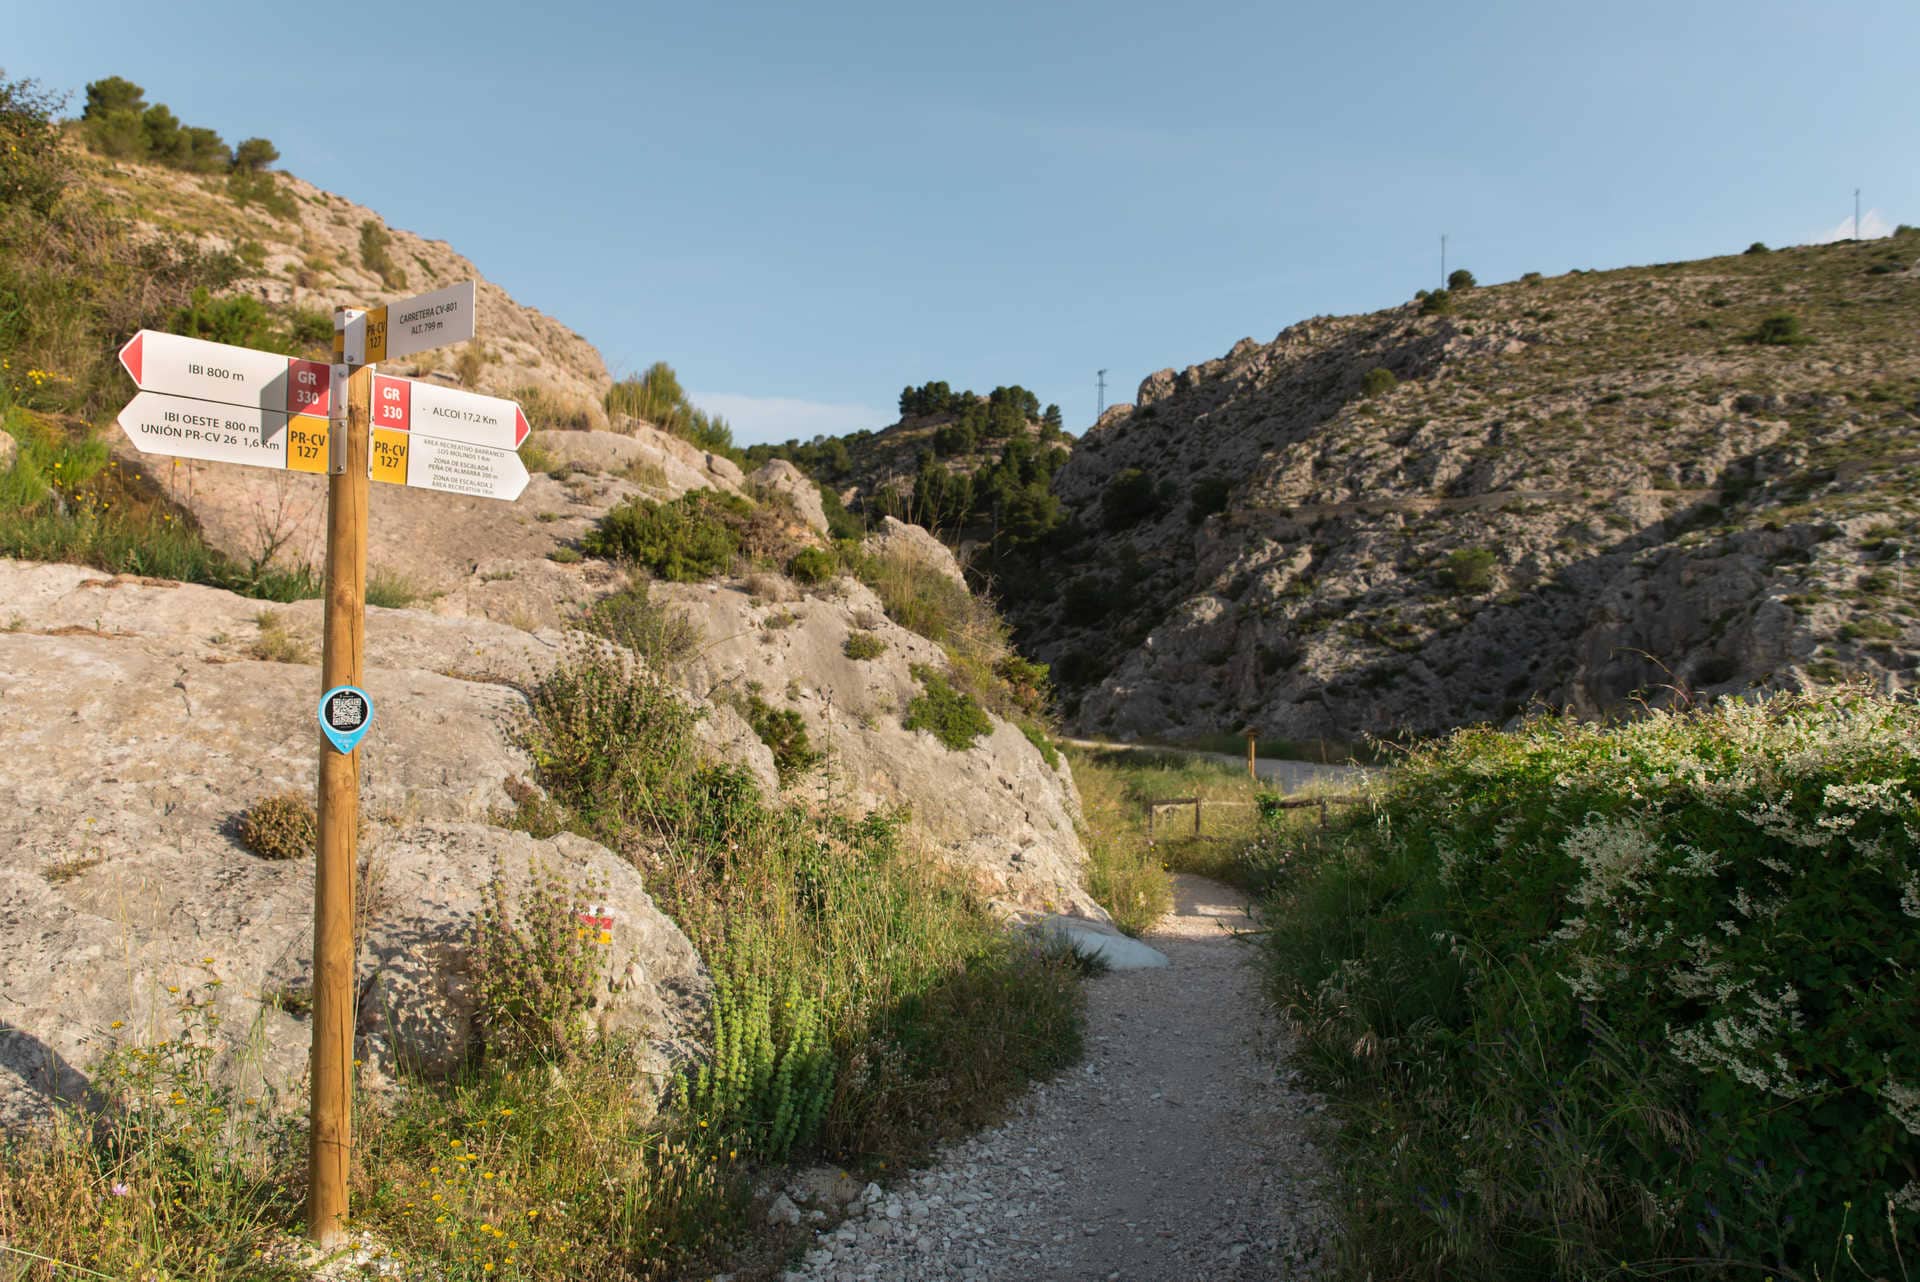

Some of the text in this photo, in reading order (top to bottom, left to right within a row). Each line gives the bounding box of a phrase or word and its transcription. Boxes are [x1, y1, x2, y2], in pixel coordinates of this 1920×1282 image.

[400, 302, 458, 324] CARRETERA CV-801
[367, 322, 386, 336] PR-CV
[411, 322, 444, 336] ALT. 799 m
[370, 336, 382, 348] 127
[189, 364, 245, 382] IBI 800 m
[297, 370, 317, 386] GR
[297, 390, 319, 405] 330
[383, 386, 400, 401] GR
[383, 404, 403, 420] 330
[432, 406, 498, 426] ALCOI 17,2 Km
[164, 411, 260, 434] IBI OESTE 800 m
[141, 423, 280, 451] UNIÓN PR-CV 26 1,6 Km
[290, 430, 326, 447] PR-CV
[297, 446, 318, 459] 127
[374, 441, 406, 457] PR-CV
[380, 456, 399, 468] 127
[433, 457, 451, 466] ZONA
[460, 461, 489, 472] ESCALADA
[433, 474, 450, 482] ZONA
